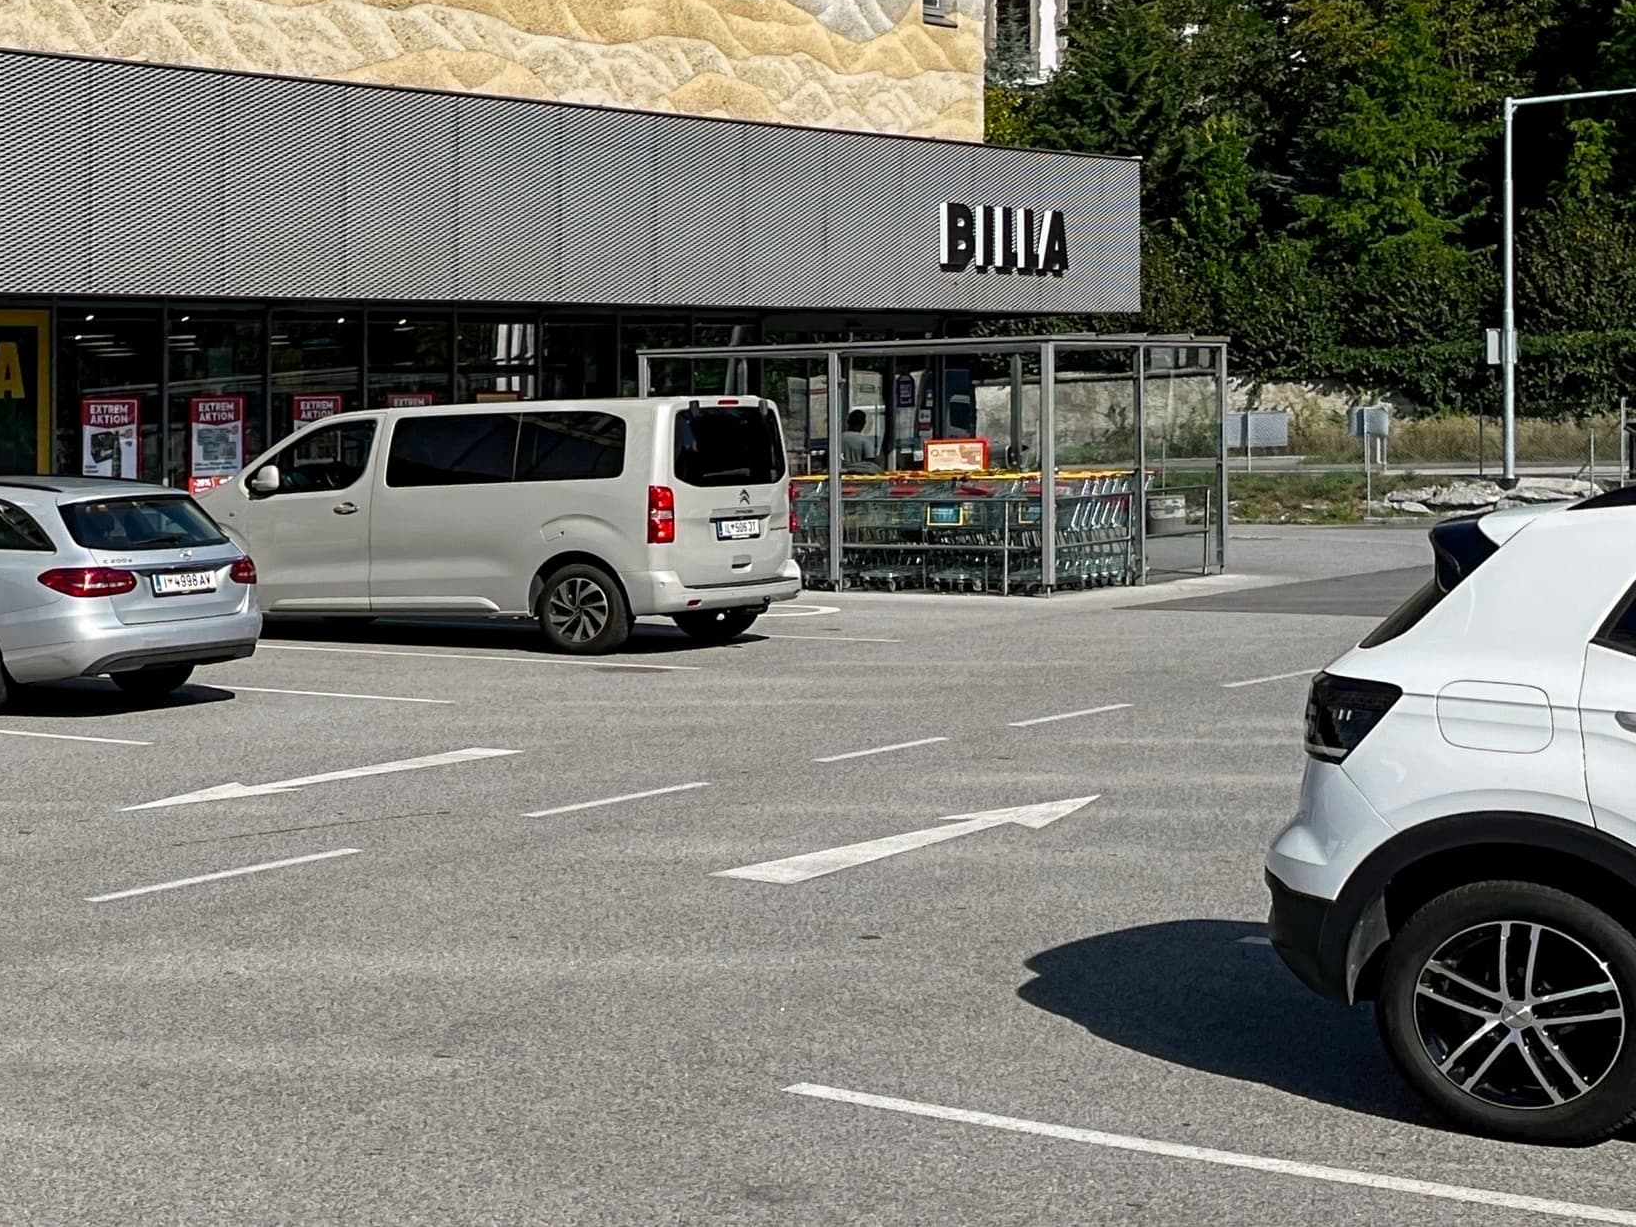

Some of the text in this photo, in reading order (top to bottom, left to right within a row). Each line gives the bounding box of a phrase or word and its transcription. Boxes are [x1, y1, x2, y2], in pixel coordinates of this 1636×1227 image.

[939, 202, 1069, 275] BILLA
[89, 404, 129, 414] EXTREM
[198, 401, 235, 412] EXTREM
[299, 400, 334, 411] EXTREM
[89, 414, 129, 424] AKTION
[198, 412, 235, 422] AKTION
[300, 410, 334, 420] AKTION
